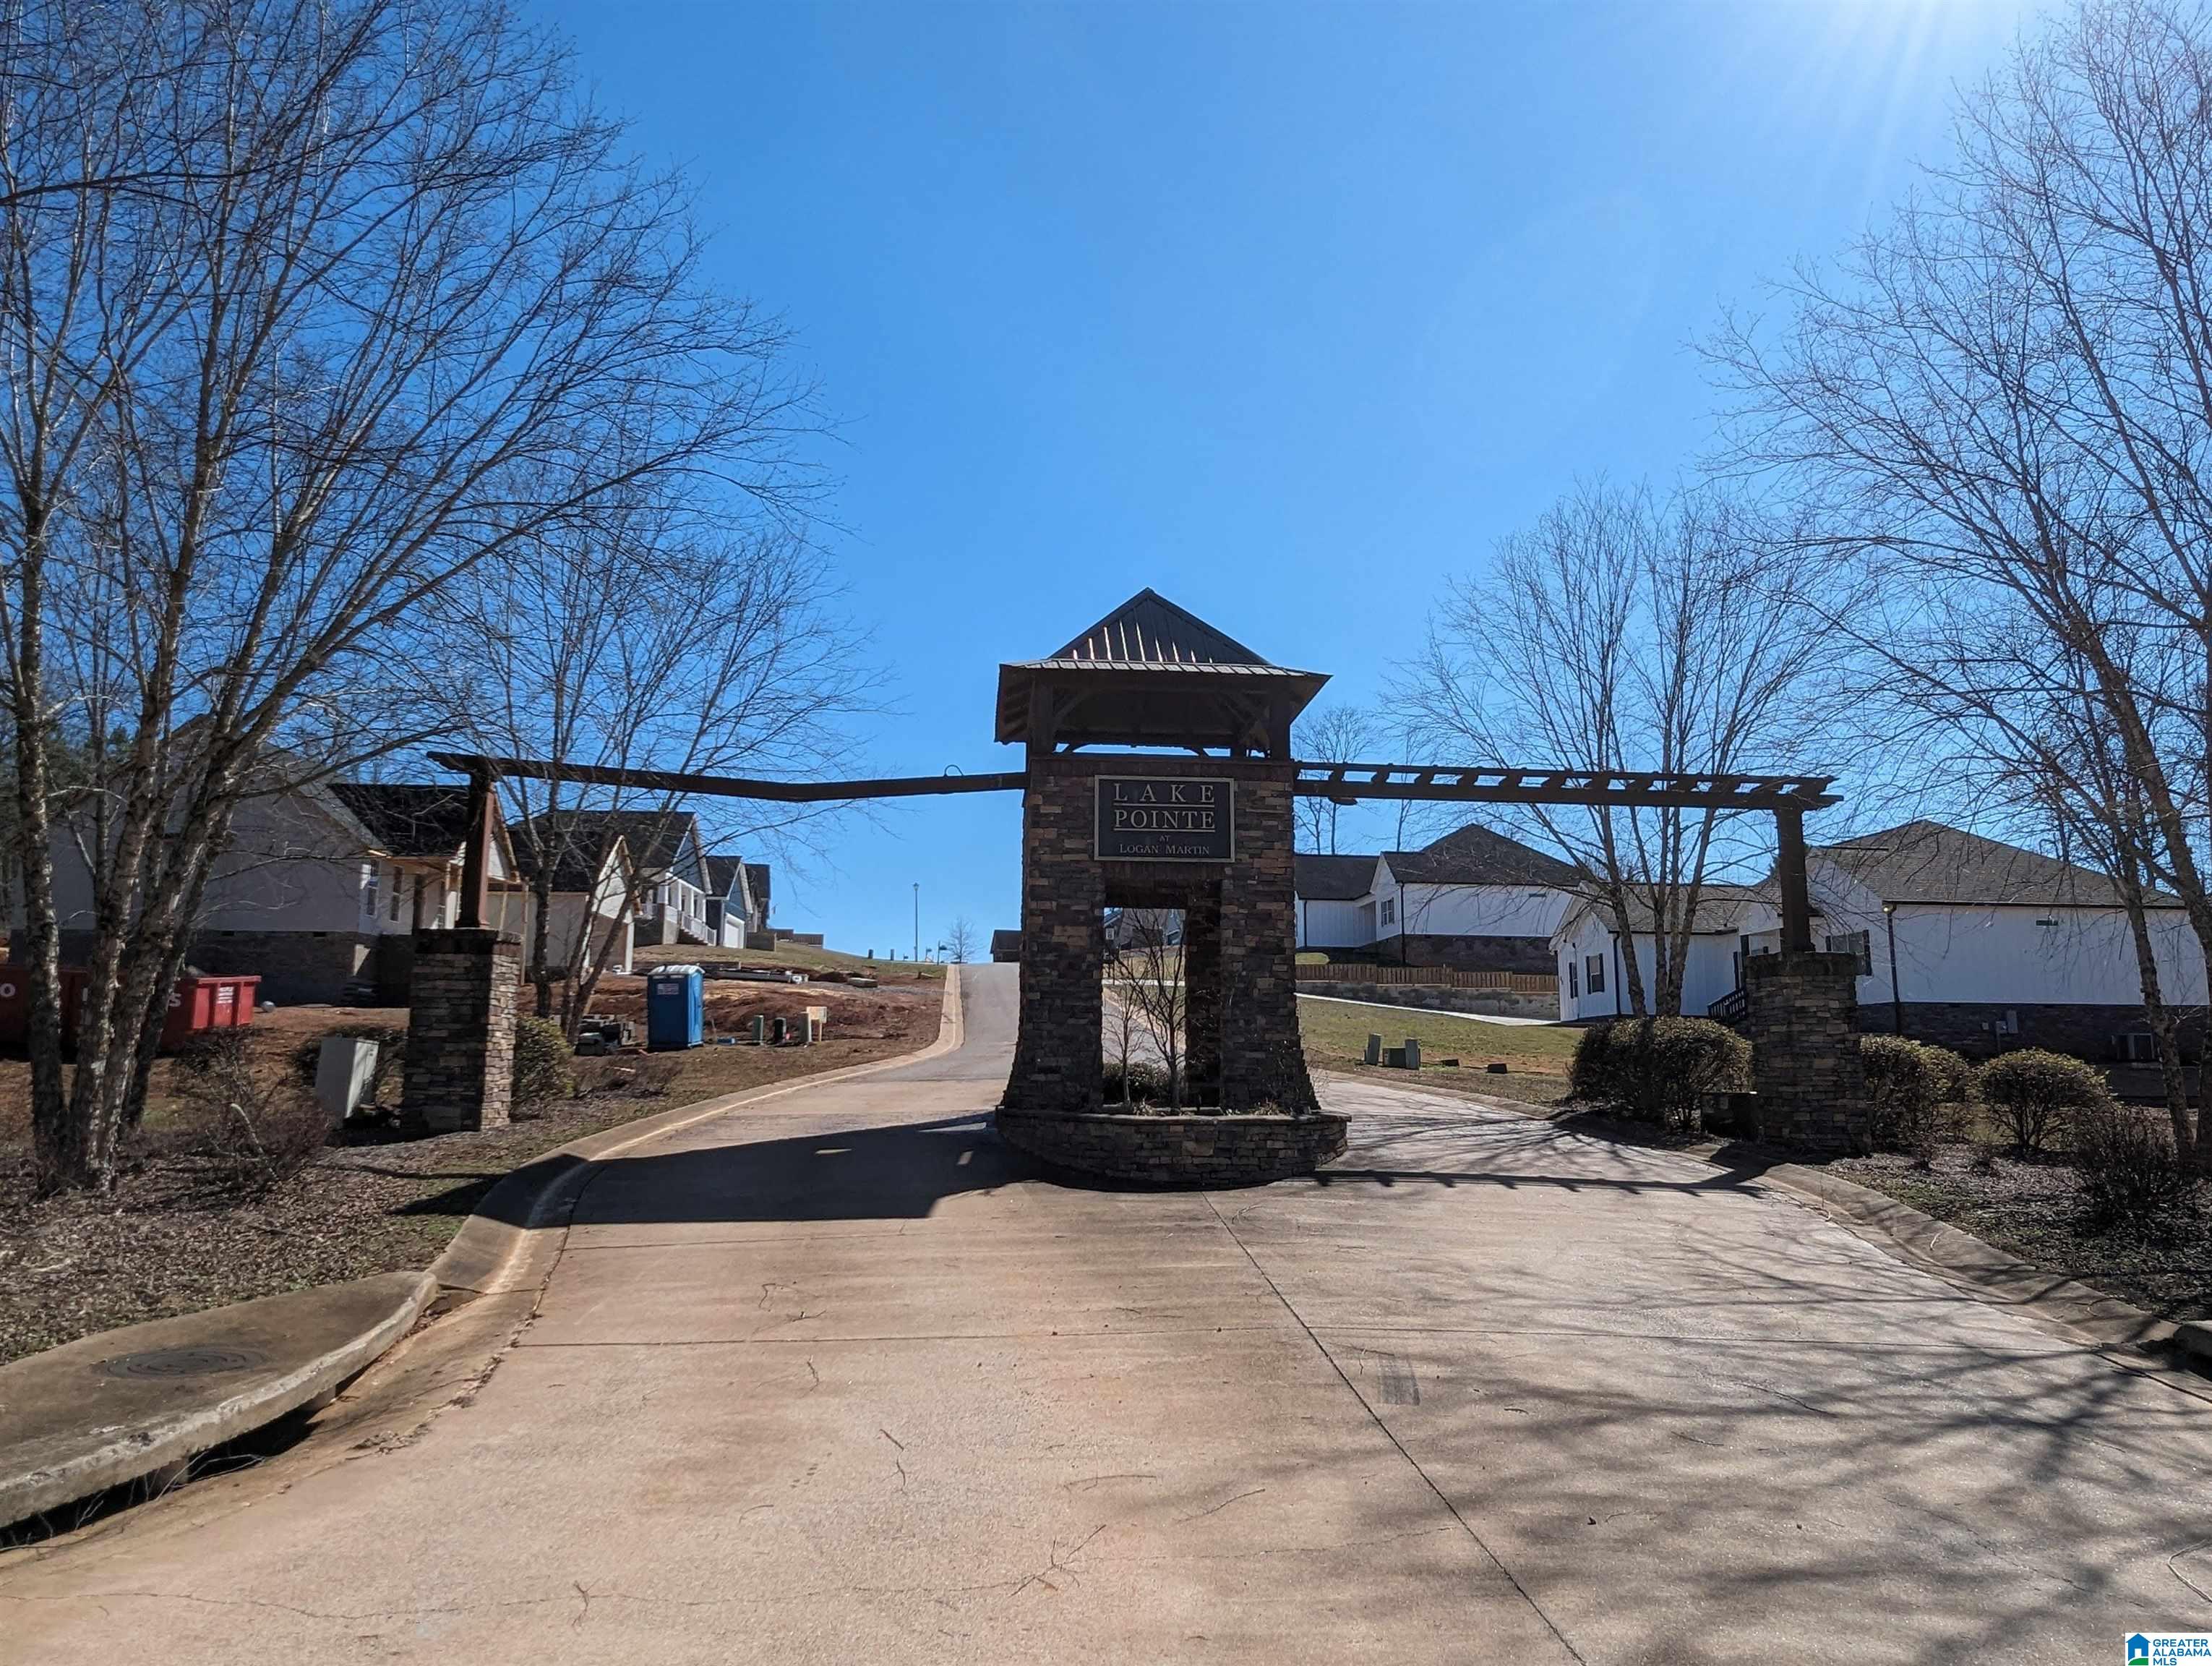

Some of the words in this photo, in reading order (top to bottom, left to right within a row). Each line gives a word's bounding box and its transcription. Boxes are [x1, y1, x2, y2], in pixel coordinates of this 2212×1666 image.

[1114, 783, 1214, 803] LAKE
[1114, 809, 1215, 829] POINTE
[1120, 844, 1158, 854] LOGAN
[1165, 845, 1209, 855] MARTIN
